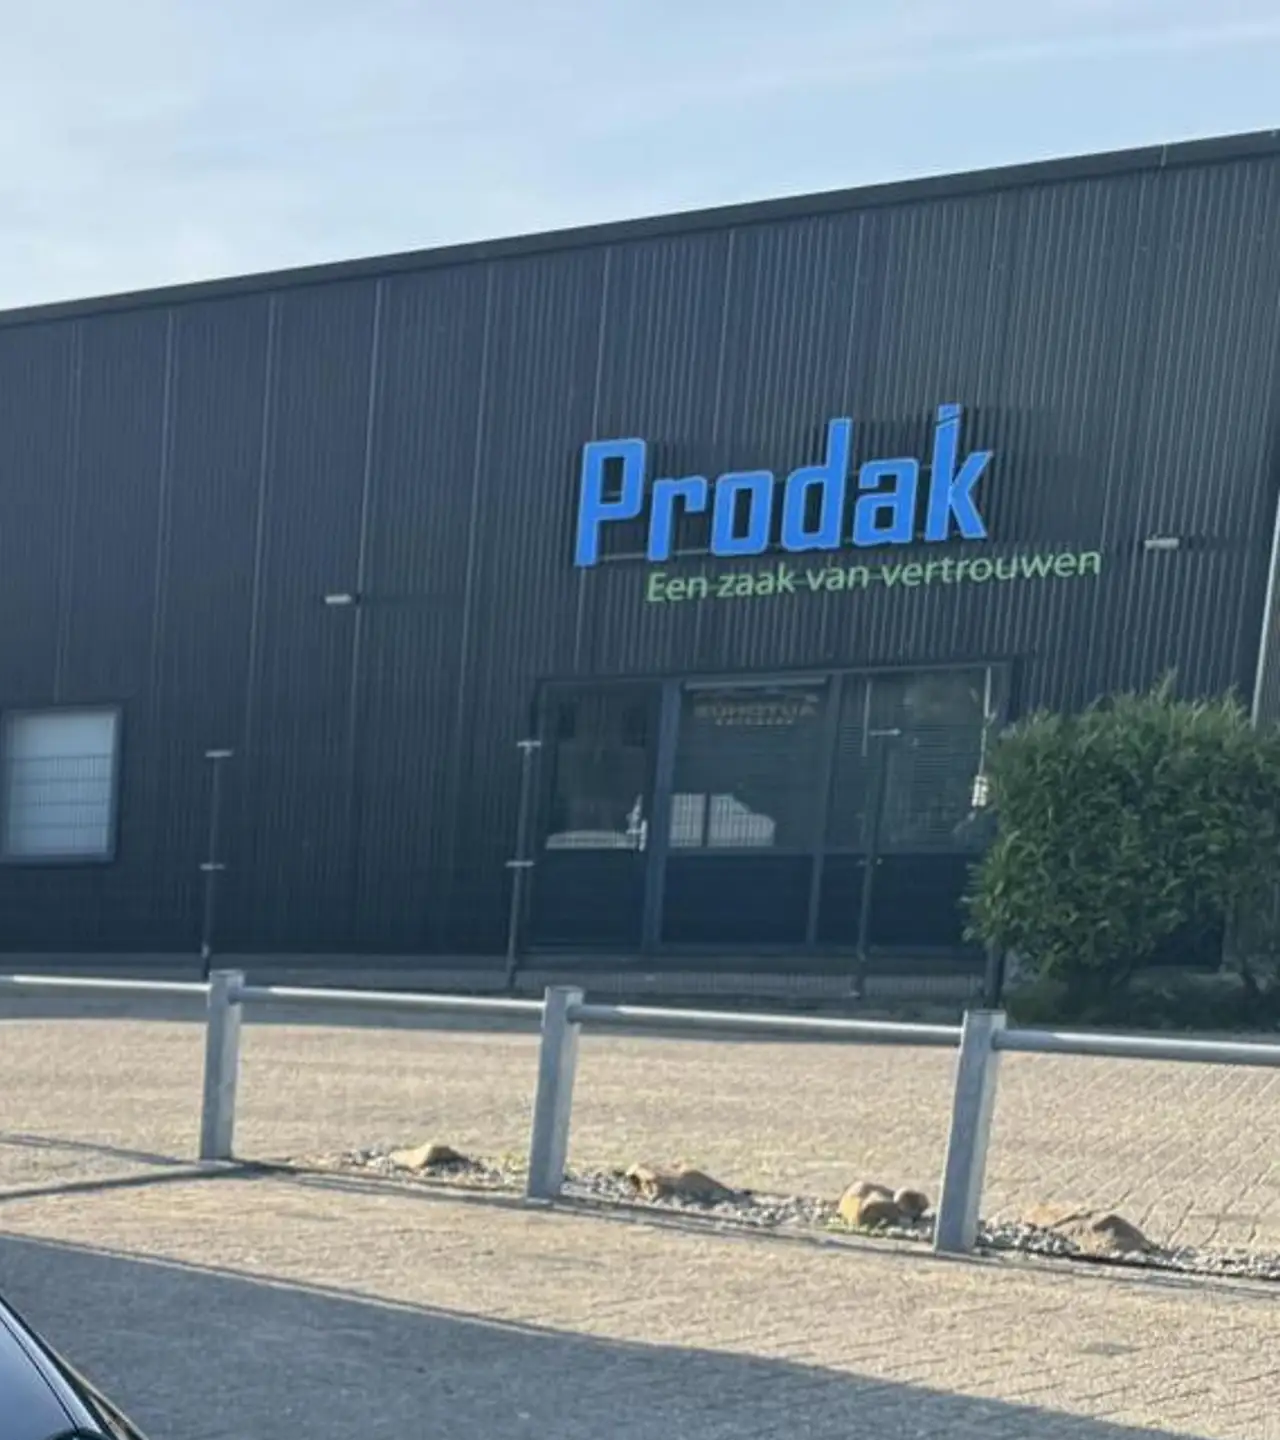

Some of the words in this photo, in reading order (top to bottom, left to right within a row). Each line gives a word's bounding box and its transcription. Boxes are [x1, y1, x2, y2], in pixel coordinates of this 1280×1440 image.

[574, 403, 994, 567] Prodak
[647, 570, 708, 602] Een
[717, 562, 797, 599] zaak
[805, 562, 870, 592] van
[882, 549, 1102, 586] vertrouwen
